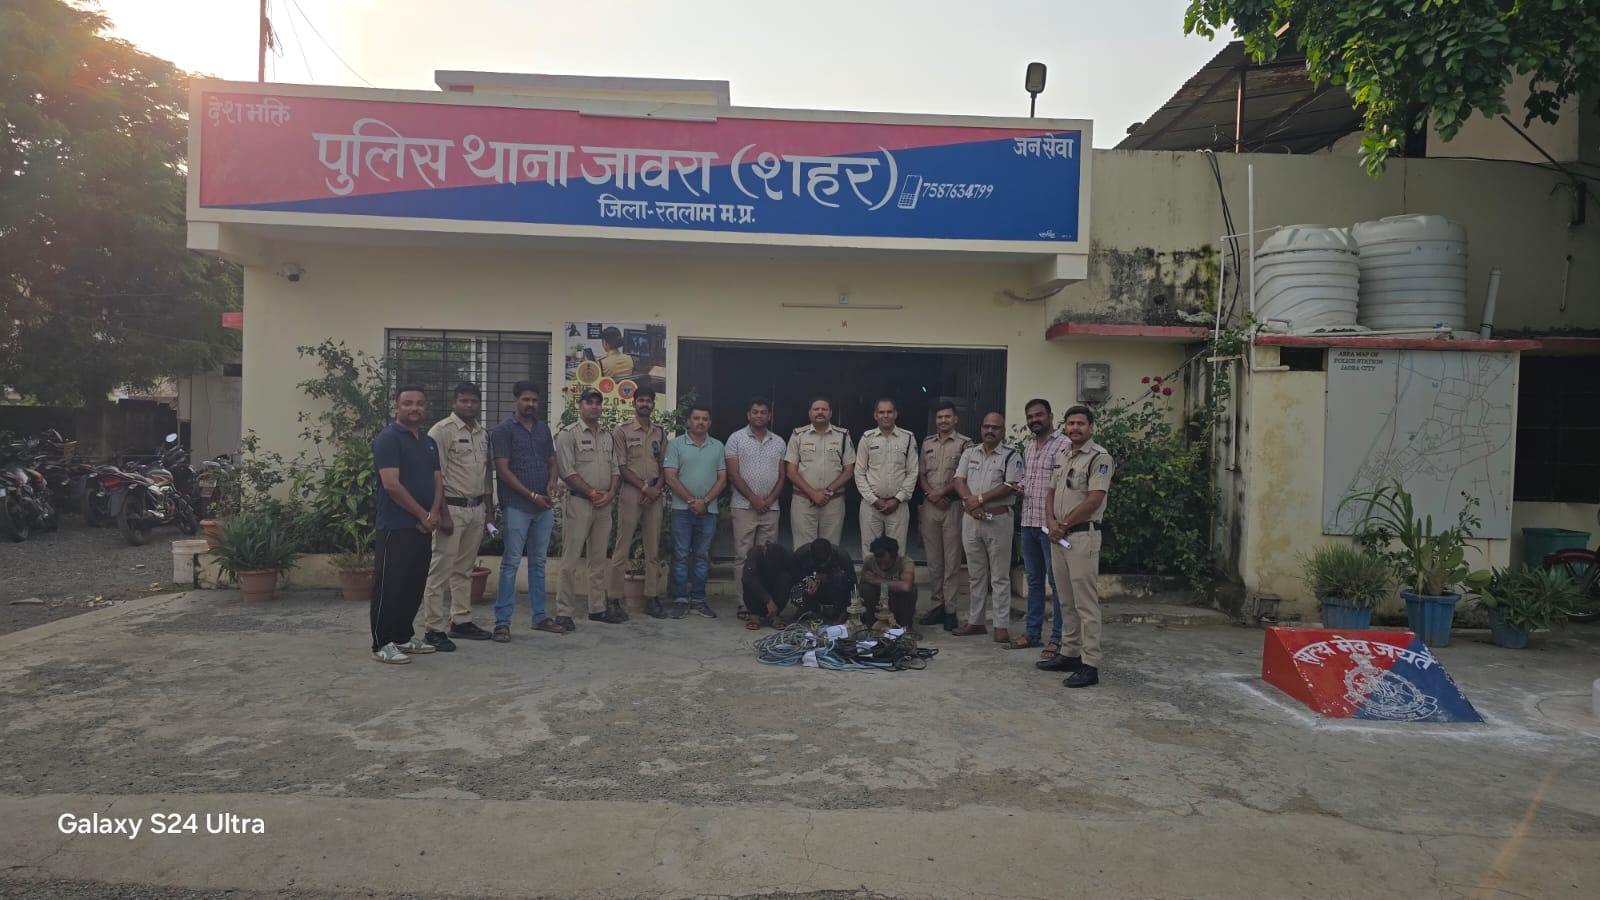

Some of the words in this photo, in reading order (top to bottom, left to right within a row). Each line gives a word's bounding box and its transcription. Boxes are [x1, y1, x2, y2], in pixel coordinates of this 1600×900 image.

[311, 118, 455, 196] पुलिस
[462, 134, 575, 188] थाना
[579, 145, 719, 197] जावरा
[730, 143, 898, 211] (शहर)
[1012, 137, 1042, 158] जन
[1042, 132, 1074, 160] सेवा
